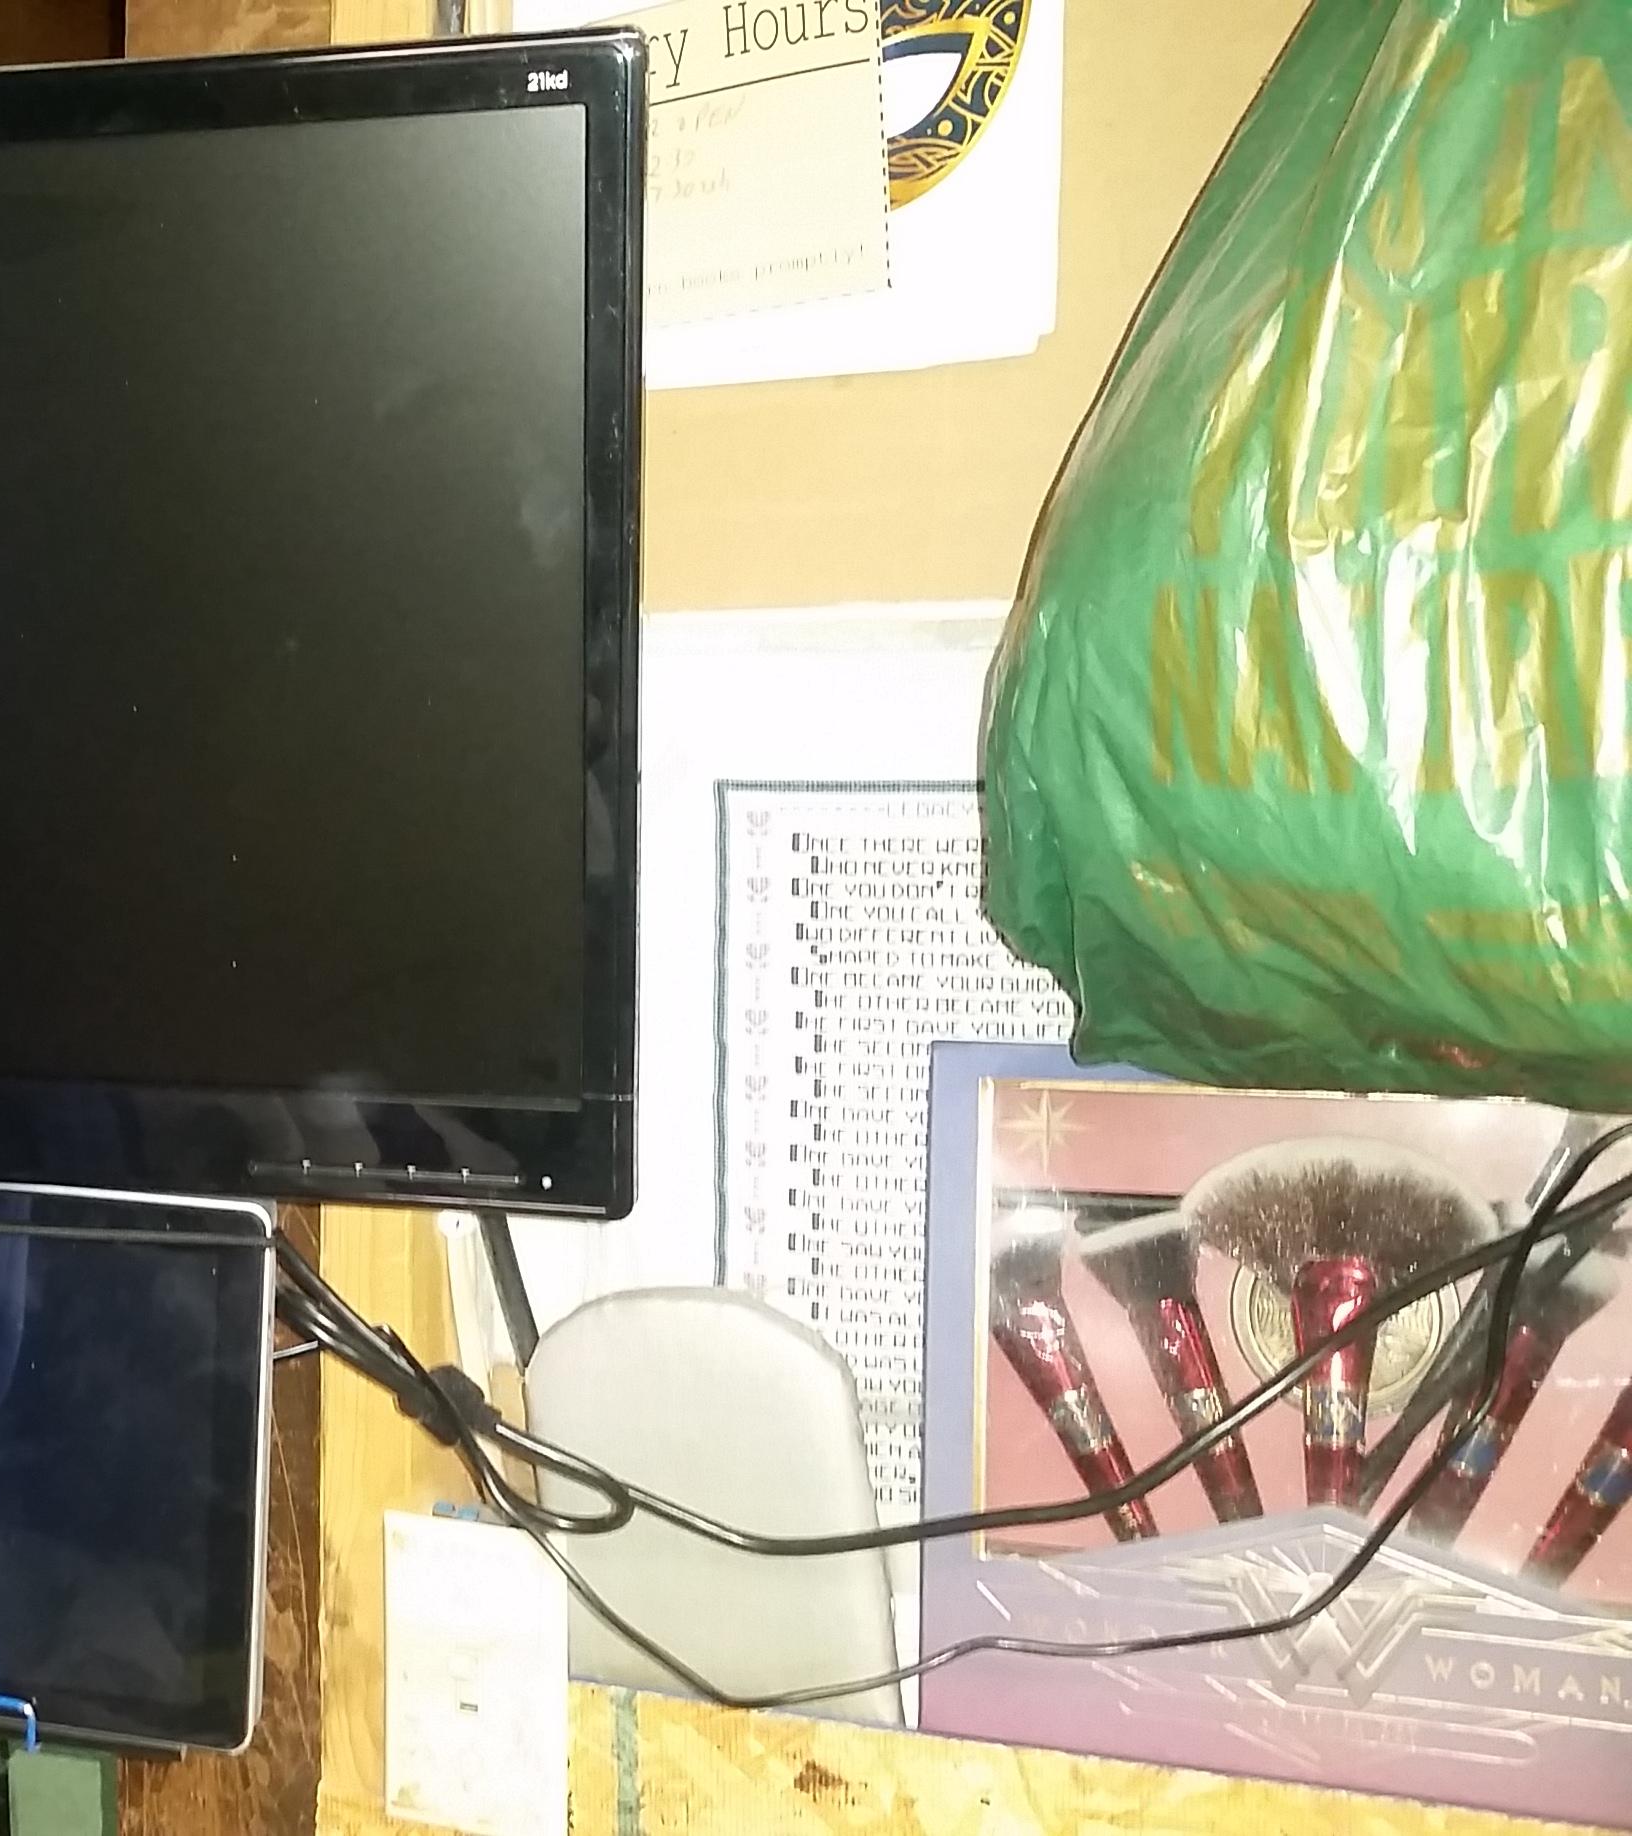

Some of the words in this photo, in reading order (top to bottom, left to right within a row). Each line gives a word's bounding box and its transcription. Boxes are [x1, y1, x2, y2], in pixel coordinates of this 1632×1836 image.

[723, 0, 869, 58] Hours
[527, 69, 568, 92] 21kd
[1020, 1611, 1228, 1660] WONR
[1423, 1652, 1622, 1705] WOMAN
